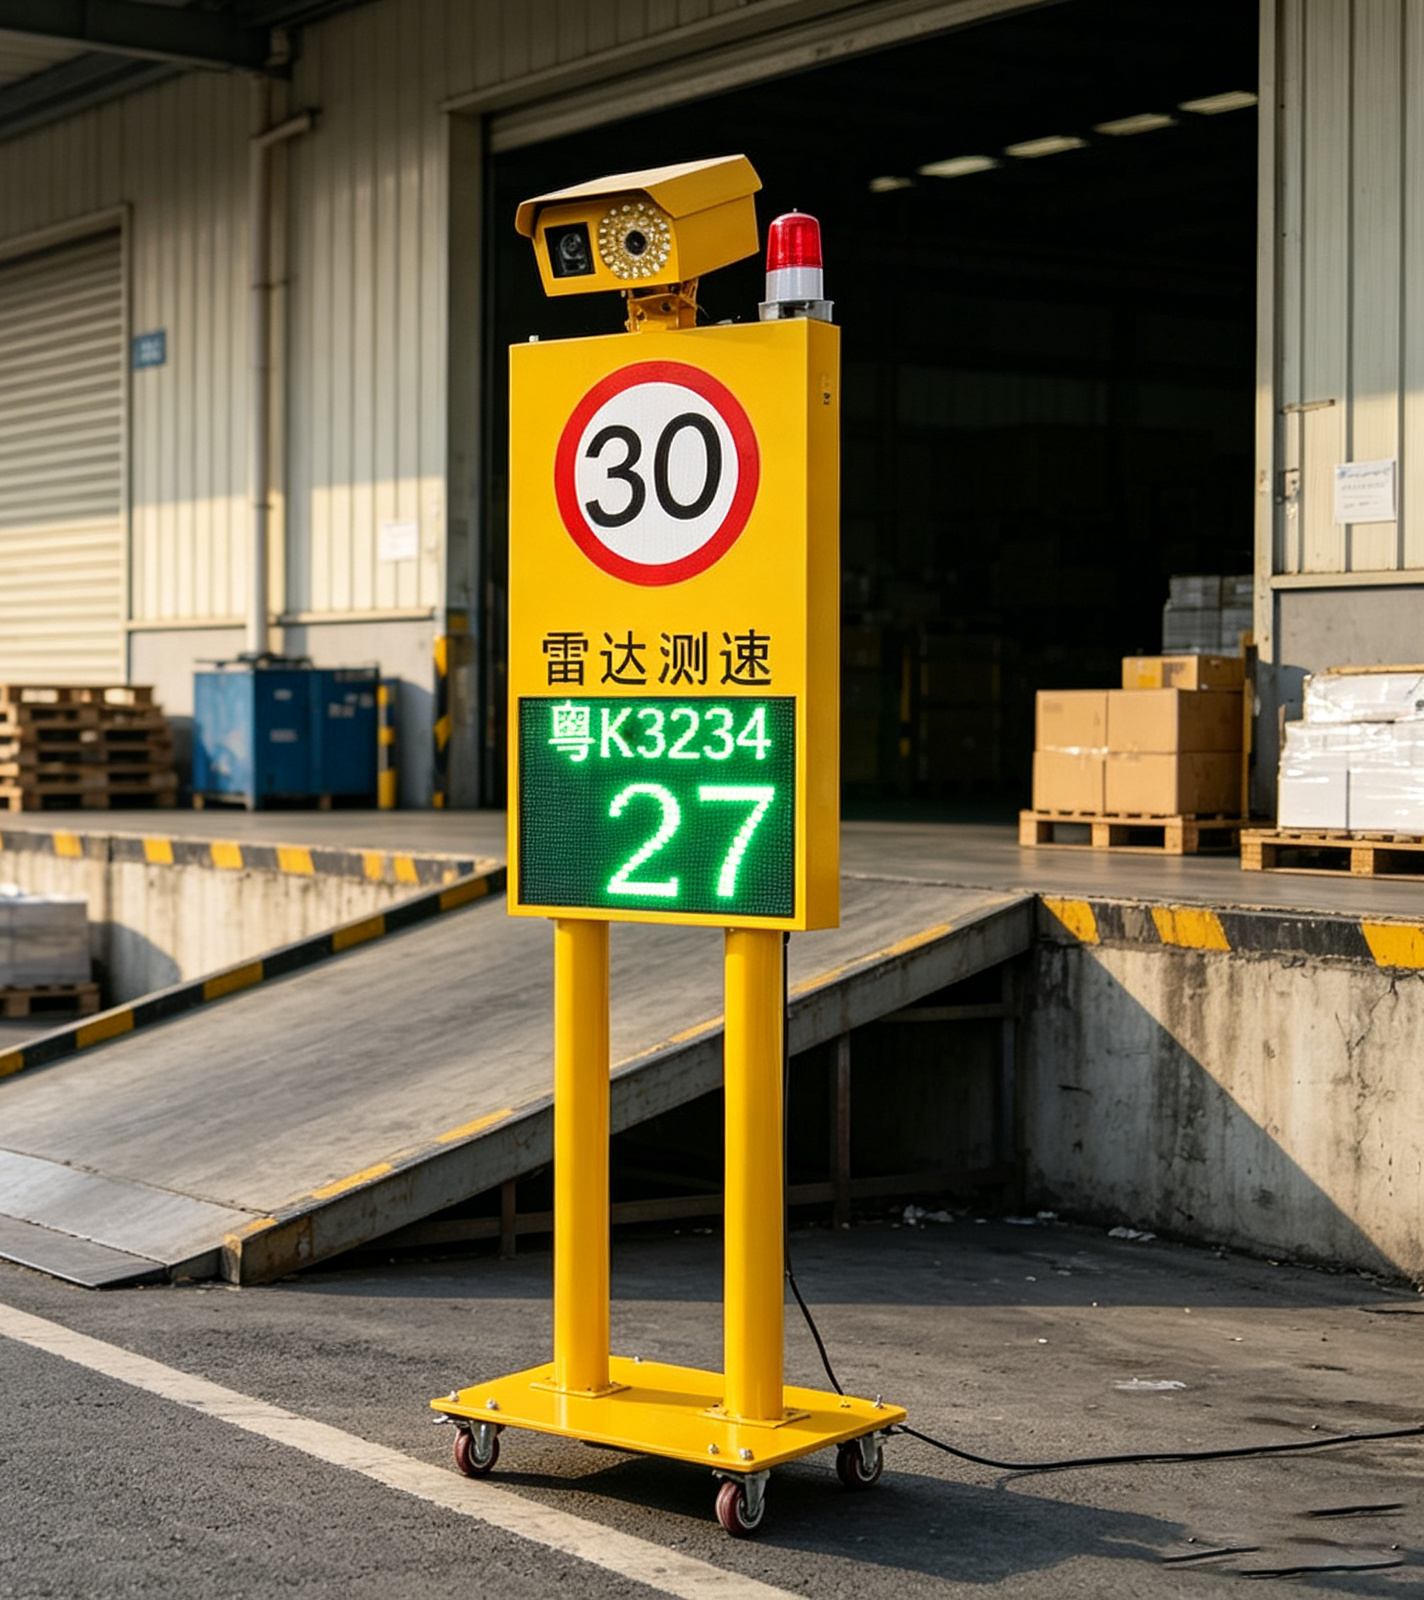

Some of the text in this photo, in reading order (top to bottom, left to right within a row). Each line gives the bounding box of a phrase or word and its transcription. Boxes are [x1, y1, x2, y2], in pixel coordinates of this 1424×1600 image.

[584, 412, 722, 528] 30
[542, 629, 772, 686] 雷达测速
[548, 701, 772, 762] 粤K3234
[607, 783, 776, 898] 27
